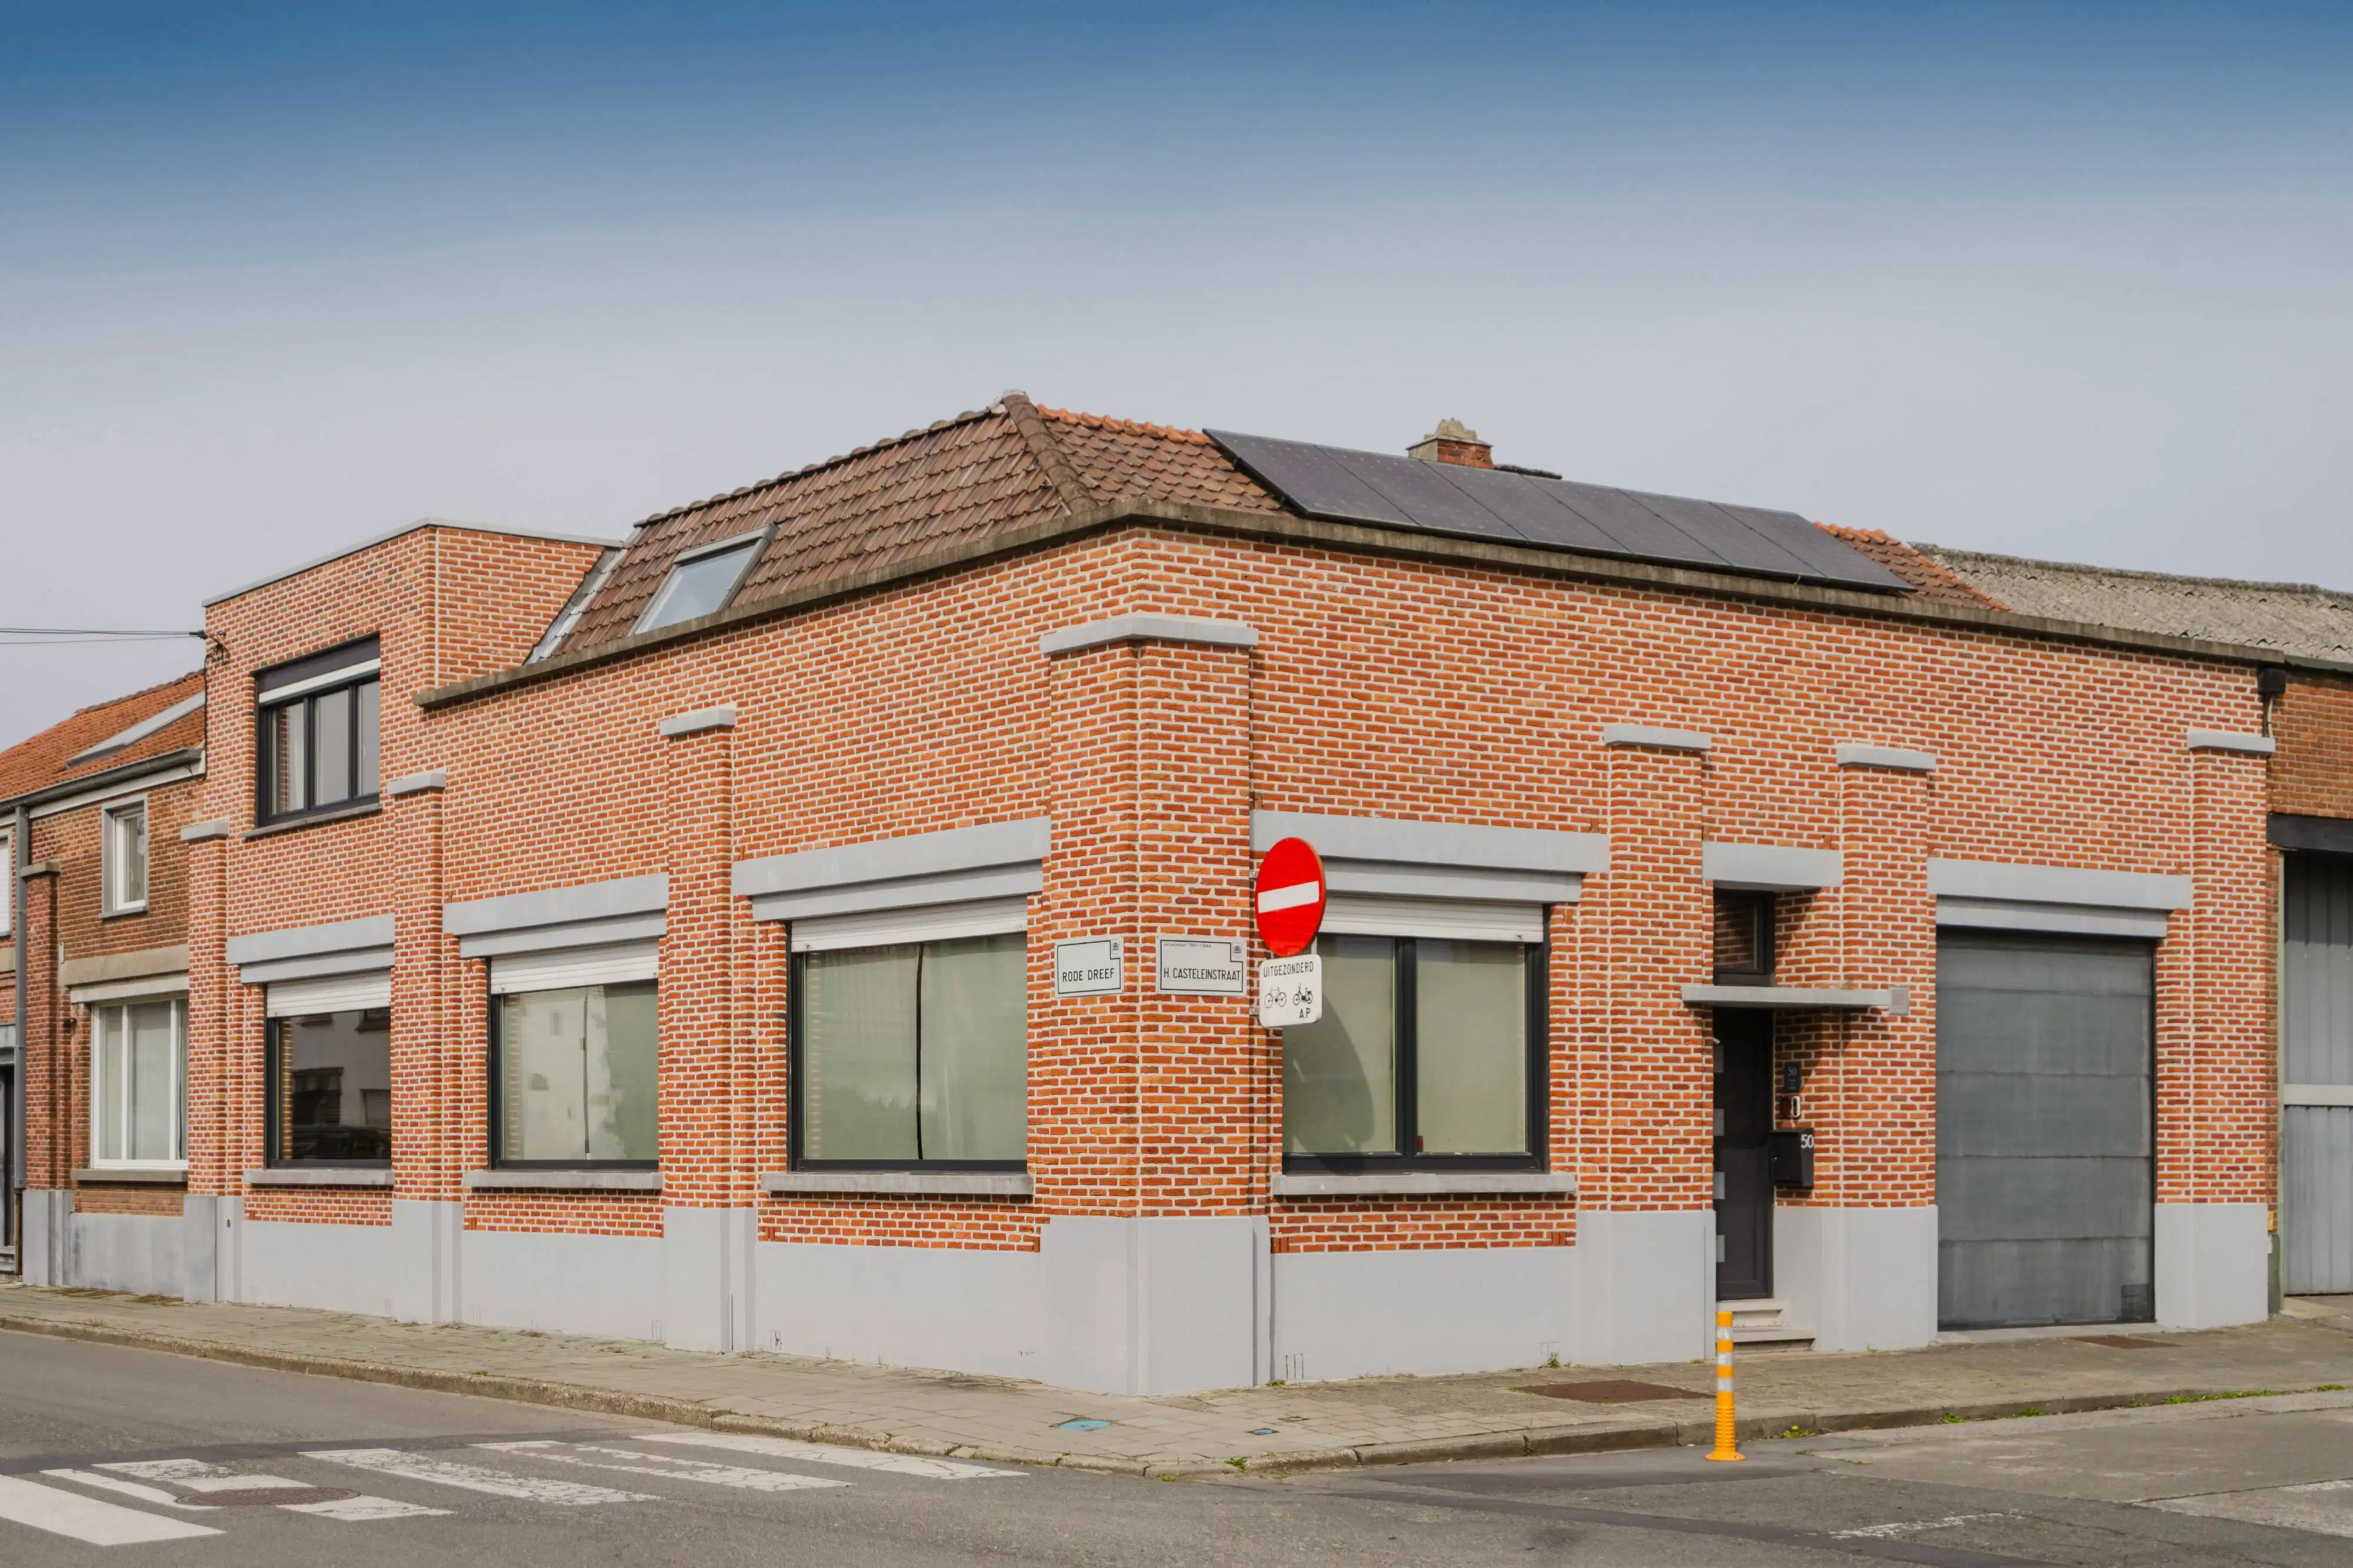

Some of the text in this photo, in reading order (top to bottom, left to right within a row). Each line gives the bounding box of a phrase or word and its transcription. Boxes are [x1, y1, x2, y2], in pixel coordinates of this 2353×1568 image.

[1062, 968, 1114, 982] RODE DREEF
[1164, 968, 1241, 980] H. CASTELEINSTRAAT
[1264, 961, 1314, 978] UITGEZONDERD
[1788, 1066, 1797, 1076] 50
[1801, 1134, 1814, 1148] 50
